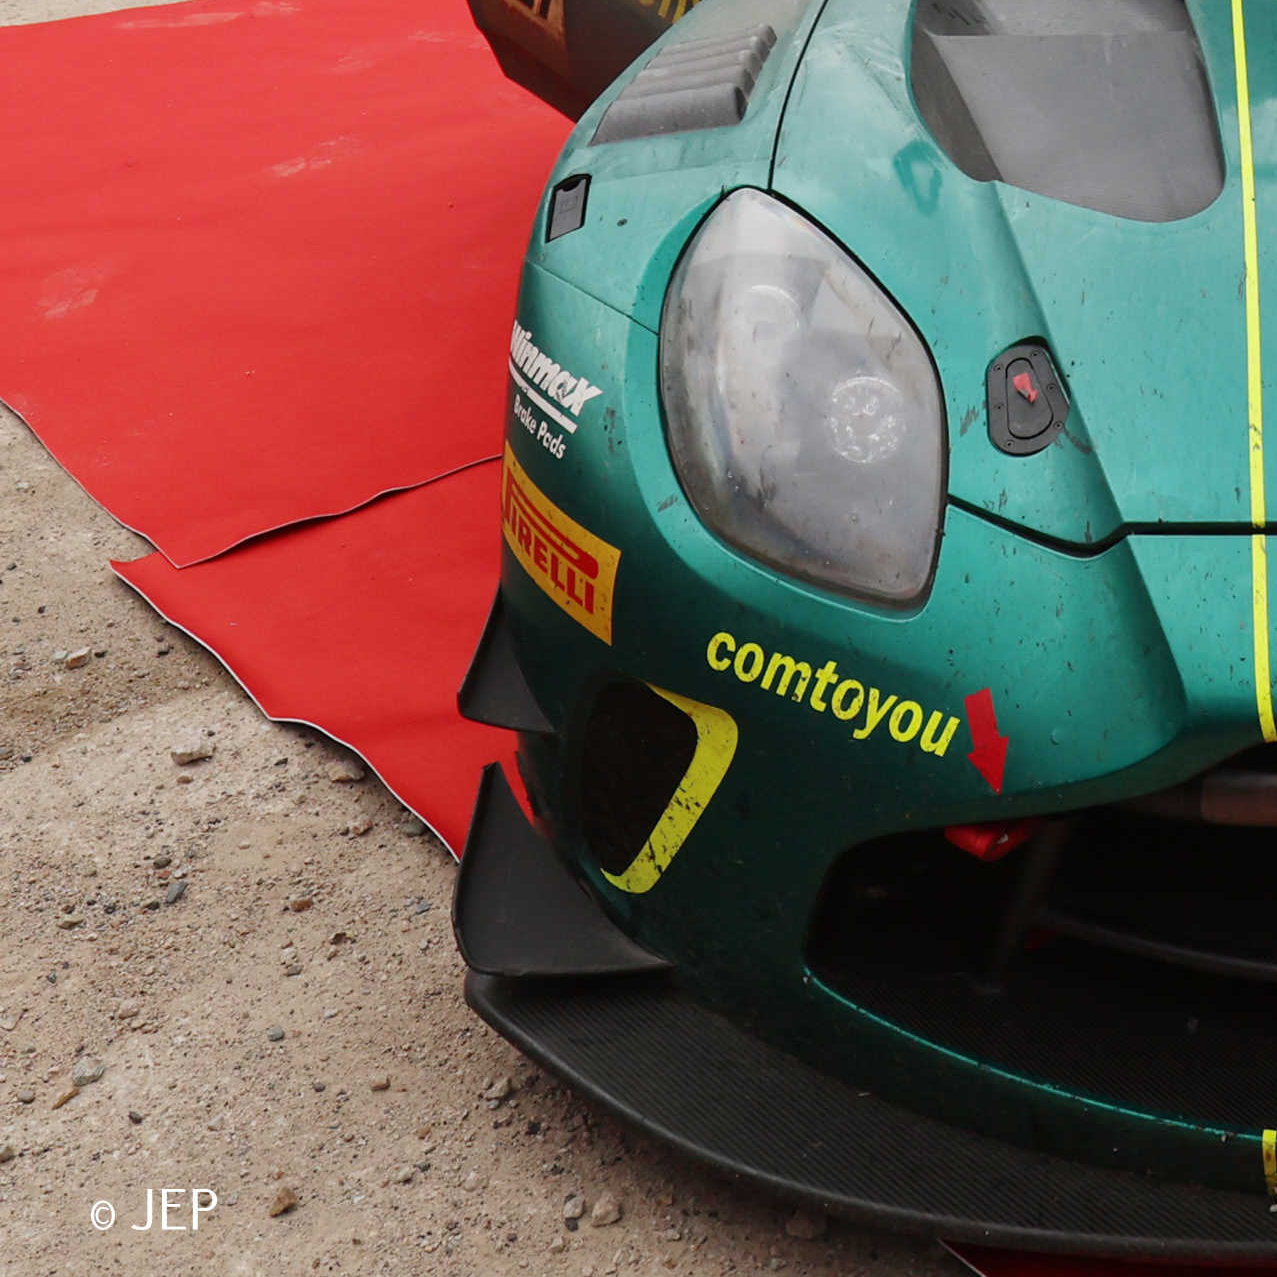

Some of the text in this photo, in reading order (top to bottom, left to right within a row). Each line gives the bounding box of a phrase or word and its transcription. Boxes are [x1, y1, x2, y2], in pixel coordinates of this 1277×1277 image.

[513, 394, 566, 459] Brake Pads
[504, 467, 600, 616] PIRELLI
[705, 630, 961, 758] comtoyou
